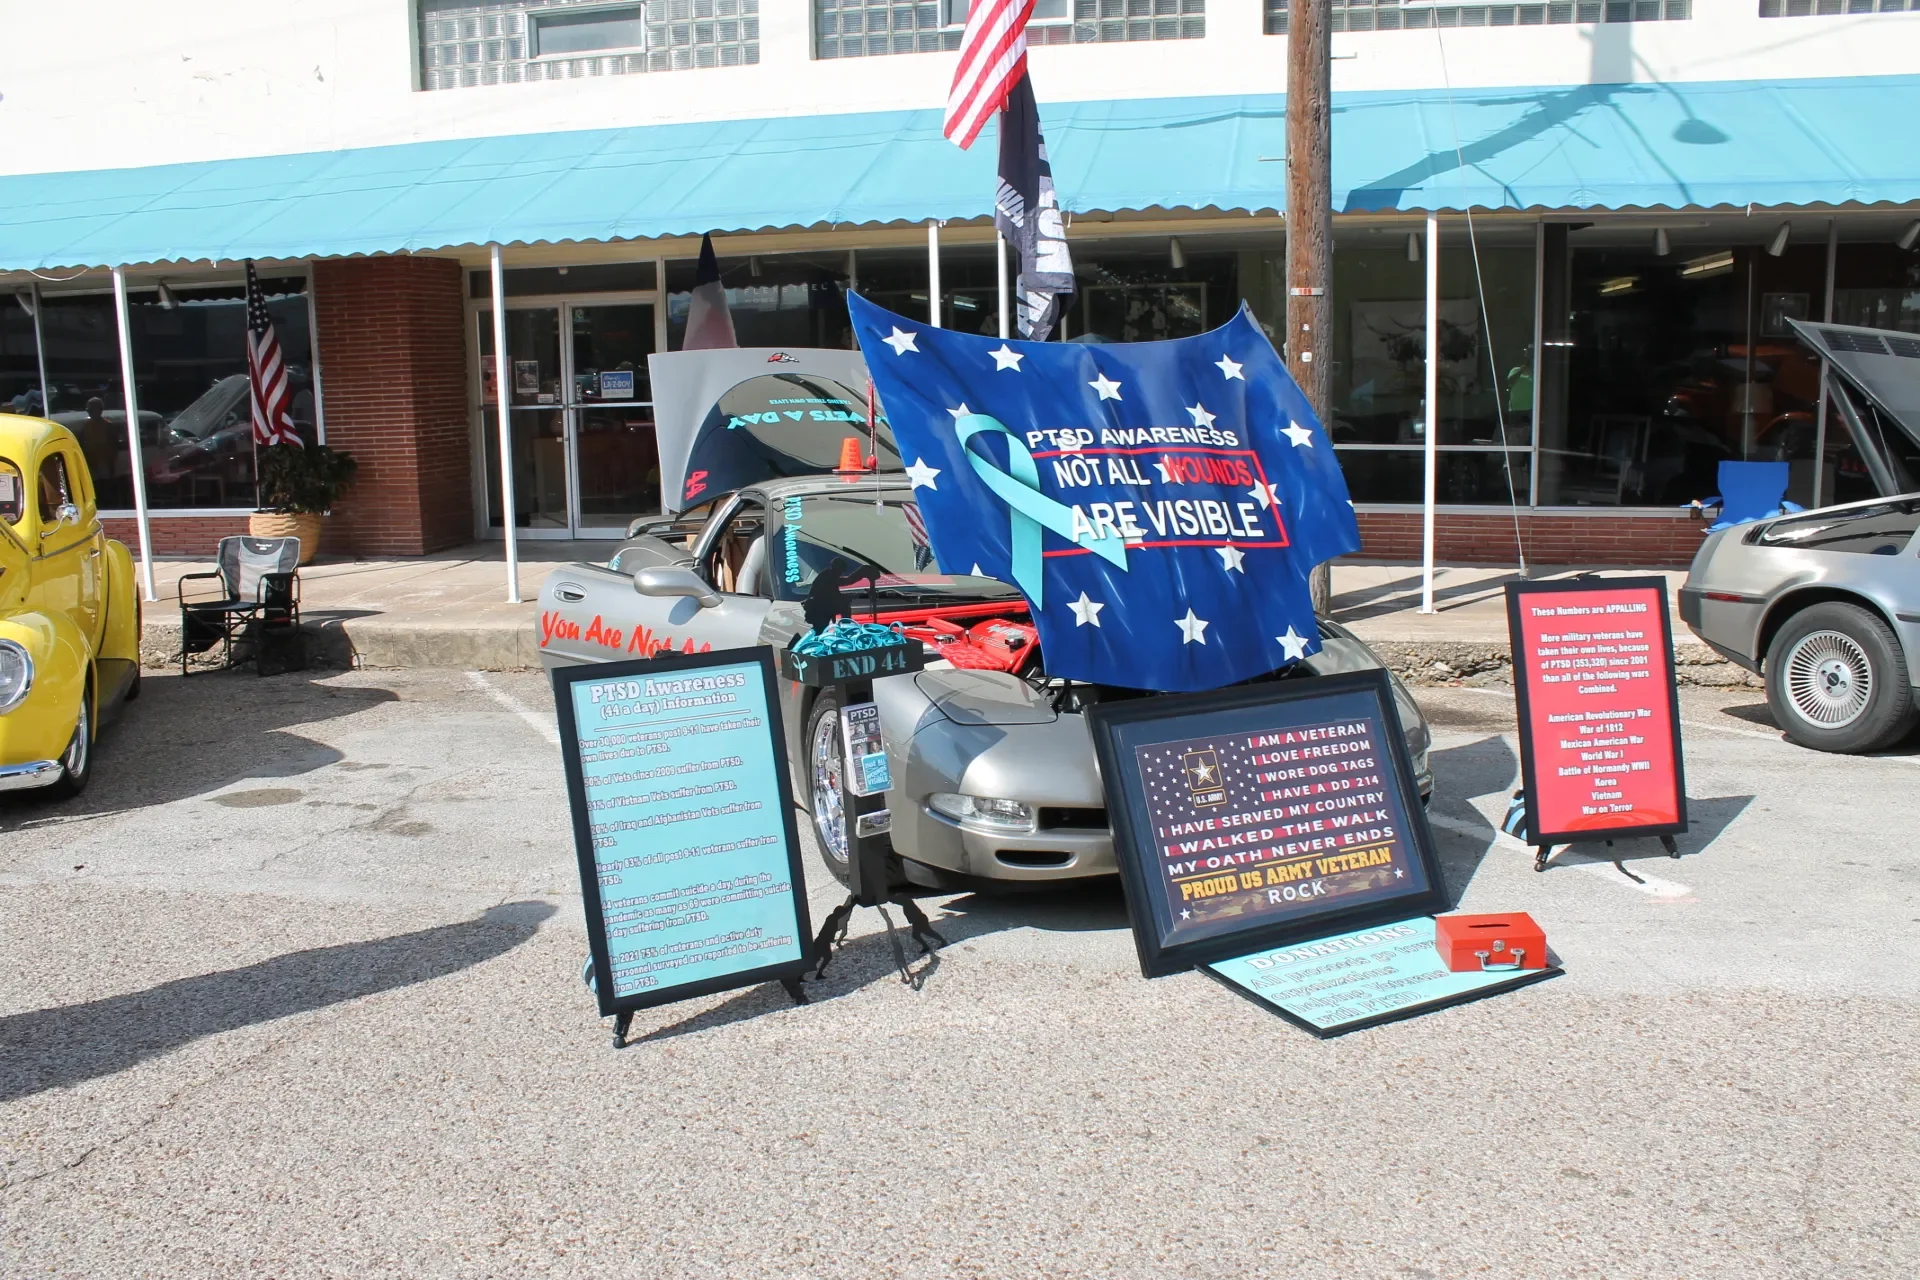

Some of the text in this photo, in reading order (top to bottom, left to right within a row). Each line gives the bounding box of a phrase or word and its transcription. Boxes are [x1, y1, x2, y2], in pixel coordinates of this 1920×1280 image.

[727, 411, 780, 429] DAY
[783, 410, 804, 421] A
[808, 409, 867, 425] VETS
[1025, 426, 1239, 449] PTSD AWARENESS
[1052, 456, 1254, 489] NOT ALL WOUNDS
[1071, 499, 1265, 543] ARE VISIBLE
[784, 497, 803, 583] PTSD Awareness
[1531, 608, 1555, 616] These
[1556, 606, 1590, 615] Numbers
[1606, 603, 1647, 613] APPALLING
[540, 611, 580, 648] You
[585, 615, 622, 649] Are
[627, 624, 672, 660] Not
[1541, 630, 1643, 642] More military veterans have
[1537, 647, 1559, 656] taken
[1560, 646, 1579, 655] their
[1597, 645, 1617, 654] lives,
[1618, 644, 1649, 652] because
[832, 649, 907, 679] END 44
[1541, 660, 1549, 669] of
[1550, 659, 1571, 668] PTSD
[1609, 657, 1629, 666] since
[1630, 656, 1648, 665] 2001
[1542, 670, 1649, 682] than all of the following wars
[589, 674, 746, 703] PTSD Awareness
[1578, 684, 1617, 694] Combined.
[600, 693, 737, 718] (44 a day) Information
[850, 707, 876, 721] PTSD
[1548, 708, 1651, 722] American Revolutionary War
[579, 719, 761, 748] Over 30,000 veterans post 9-11 have taken their
[1247, 723, 1366, 748] I AM A VETERAN
[1579, 723, 1623, 734] War of 1812
[851, 736, 868, 745] ABOUT
[1560, 735, 1644, 749] Mexican American War
[582, 743, 669, 763] own lives due to PTSD.
[1251, 740, 1370, 766] I LOVE FREEDOM
[1581, 750, 1624, 761] World War I
[1256, 758, 1374, 783] I WORE DOG TAGS
[1558, 761, 1650, 776] Battle of Normandy WWII
[1260, 775, 1379, 802] I HAVE A DD 214
[1595, 778, 1617, 787] Korea
[1195, 792, 1223, 804] U.S. ARMY
[1591, 792, 1622, 800] Vietnam
[1159, 792, 1383, 838] I HAVE SERVED MY COUNTRY
[1582, 806, 1597, 814] War
[1609, 804, 1633, 812] Terror
[1164, 809, 1388, 857] I WALKED THE WALK
[1168, 826, 1394, 876] MY OATH NEVER ENDS
[1180, 847, 1392, 901] PROUD US ARMY VETERAN
[1268, 880, 1326, 904] ROCK
[605, 912, 709, 939] a day suffering from PTSD.
[1245, 925, 1418, 968] DONATIONS
